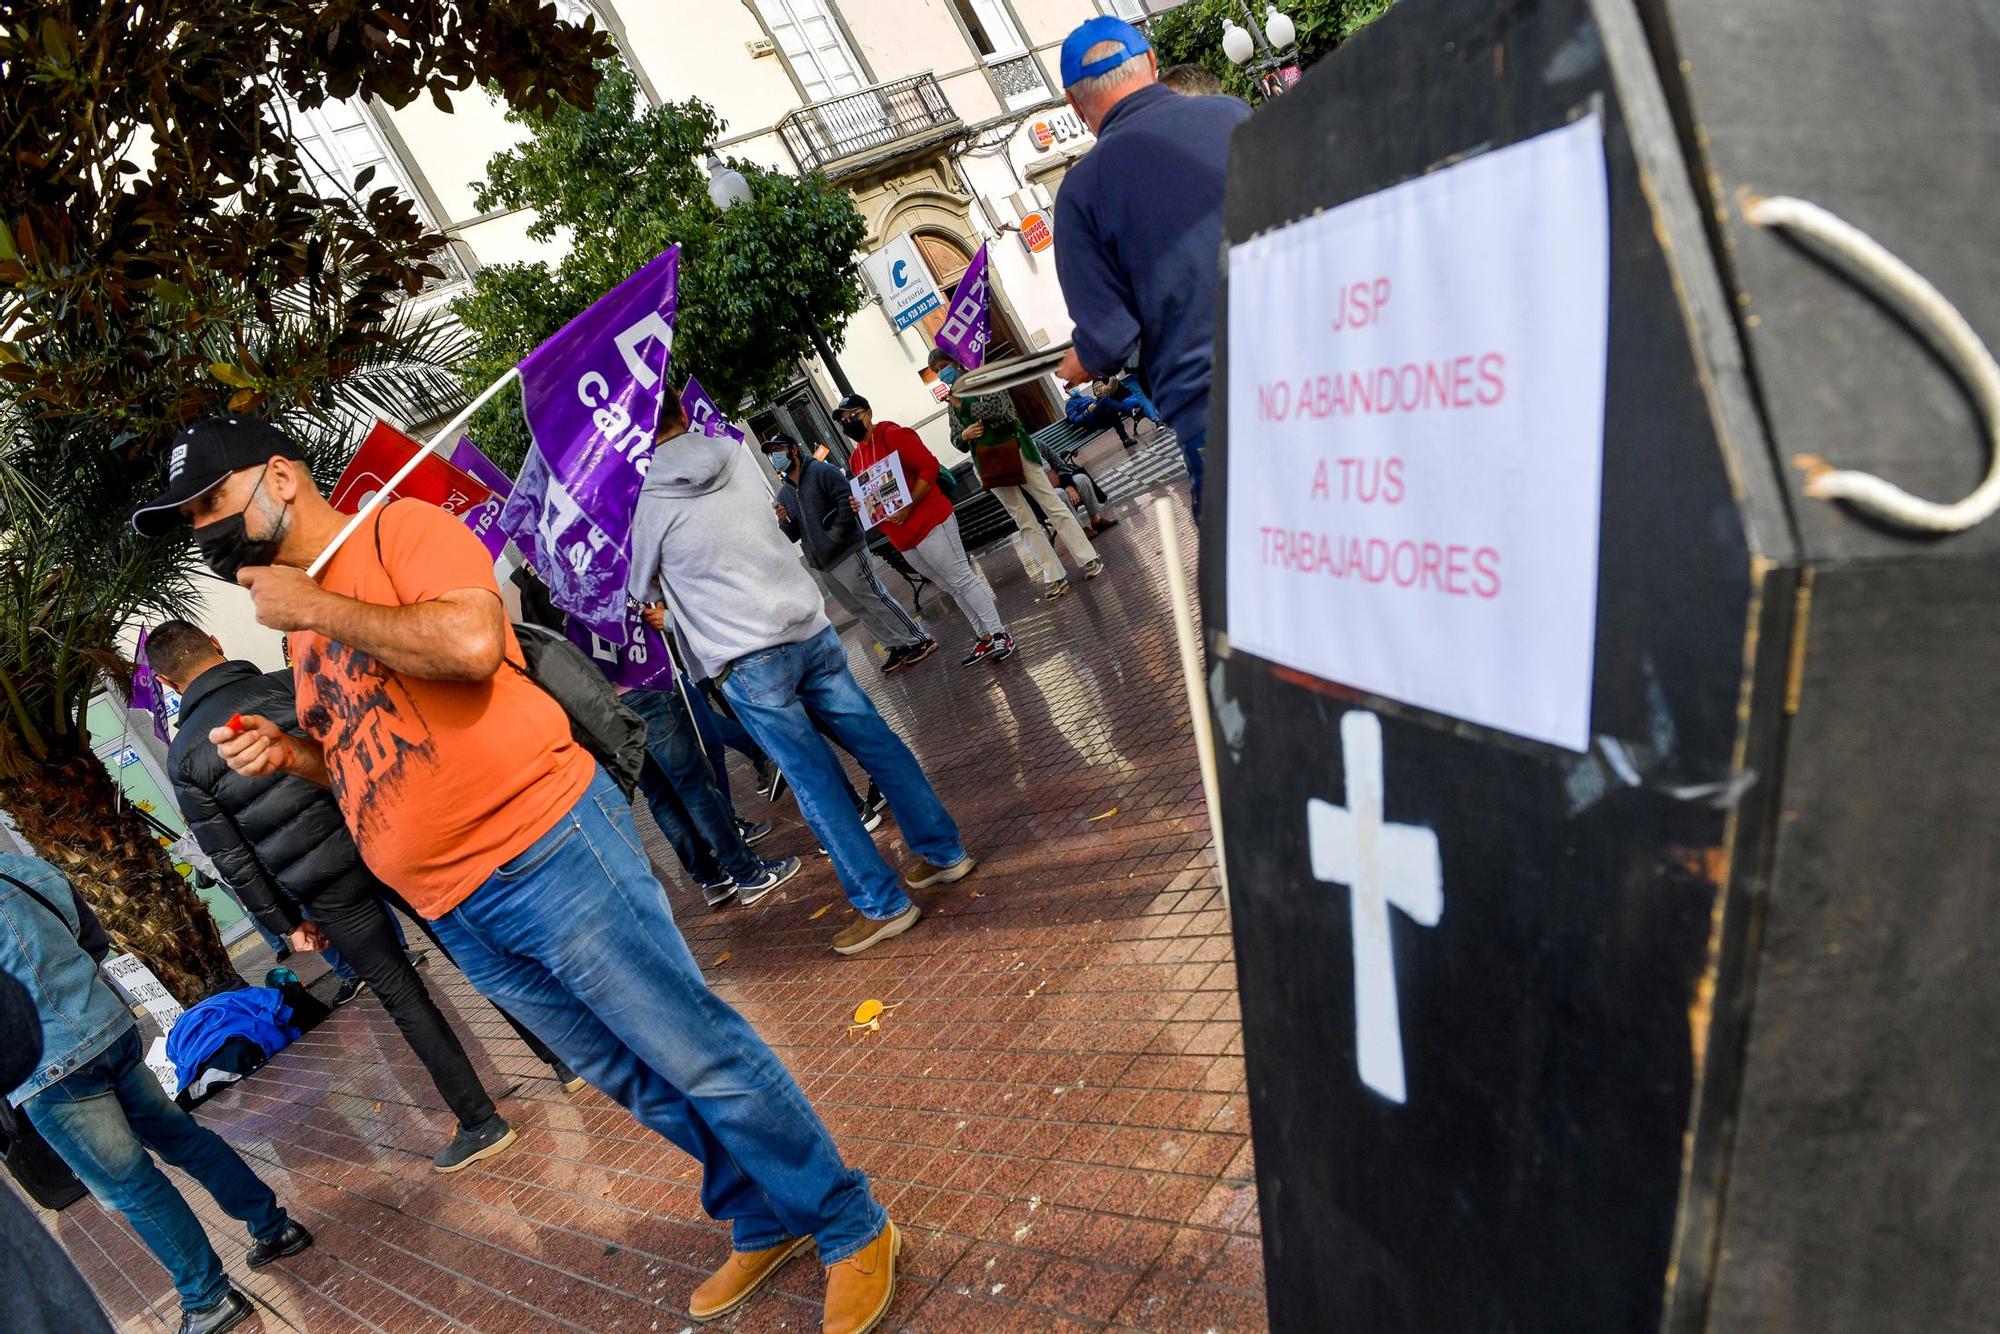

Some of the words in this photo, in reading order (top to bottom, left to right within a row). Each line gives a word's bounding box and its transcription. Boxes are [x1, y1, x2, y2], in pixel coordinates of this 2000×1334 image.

[1050, 111, 1086, 141] BU
[1023, 220, 1046, 239] BURGER
[1026, 226, 1050, 248] KING
[896, 286, 925, 311] Asesoría
[1331, 276, 1391, 332] JSP
[1256, 377, 1292, 423] NO
[1294, 351, 1507, 420] ABANDONES
[1310, 458, 1331, 503] A
[1335, 457, 1406, 505] TUS
[1258, 527, 1503, 600] TRABAJADORES
